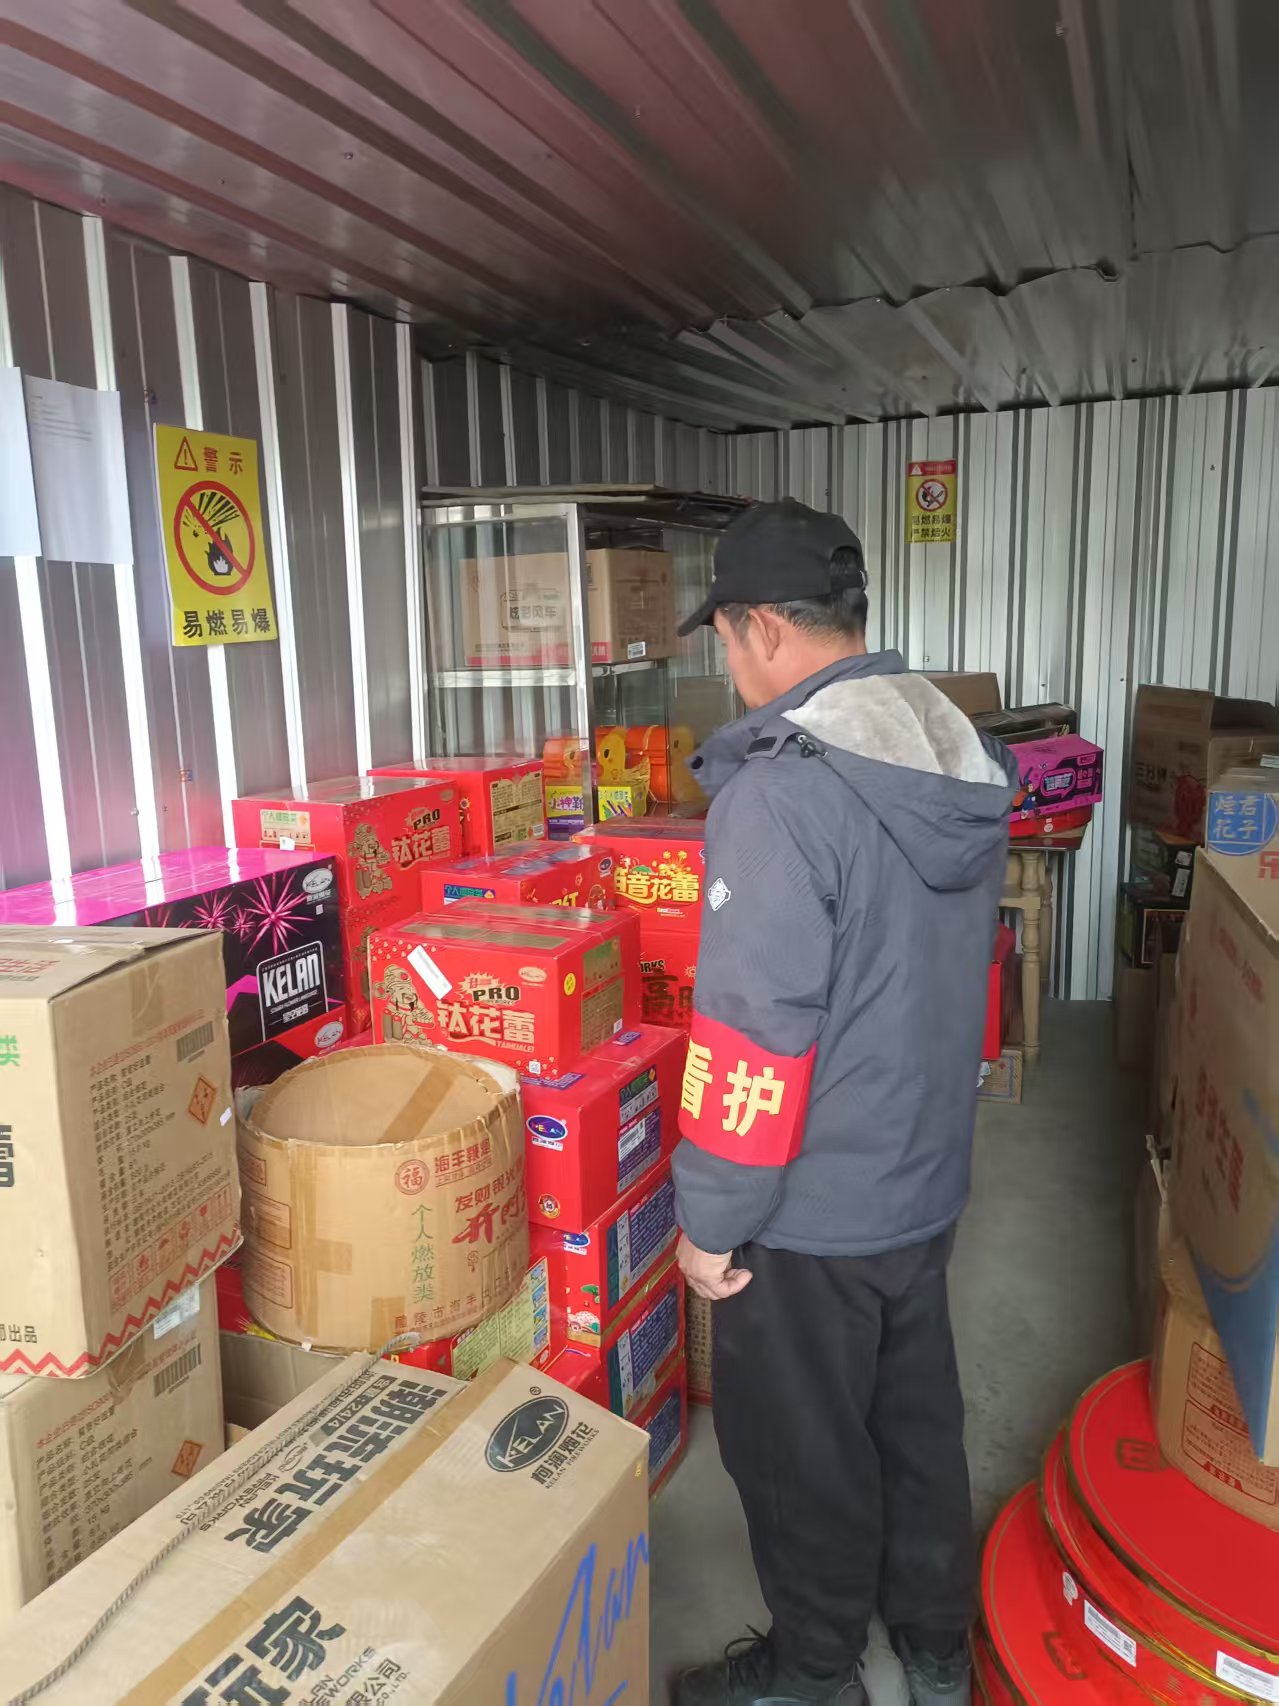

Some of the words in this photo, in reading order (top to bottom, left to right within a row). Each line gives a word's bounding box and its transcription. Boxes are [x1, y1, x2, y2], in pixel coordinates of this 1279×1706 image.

[203, 446, 244, 475] 警示
[182, 608, 271, 639] 易燃易爆
[413, 808, 440, 830] PRO
[262, 953, 321, 1008] KELAN
[472, 986, 520, 1001] PRO
[436, 1001, 535, 1044] 钛花蕾
[681, 1036, 786, 1138] 看护
[401, 1166, 423, 1188] 福
[411, 1204, 434, 1304] 个人燃放类
[495, 1403, 566, 1468] KELAN
[530, 1421, 596, 1485] 柯澜烟花
[224, 1380, 448, 1553] 潮流玩家
[239, 1473, 280, 1509] KELAN
[199, 1473, 273, 1532] FIREWORKS
